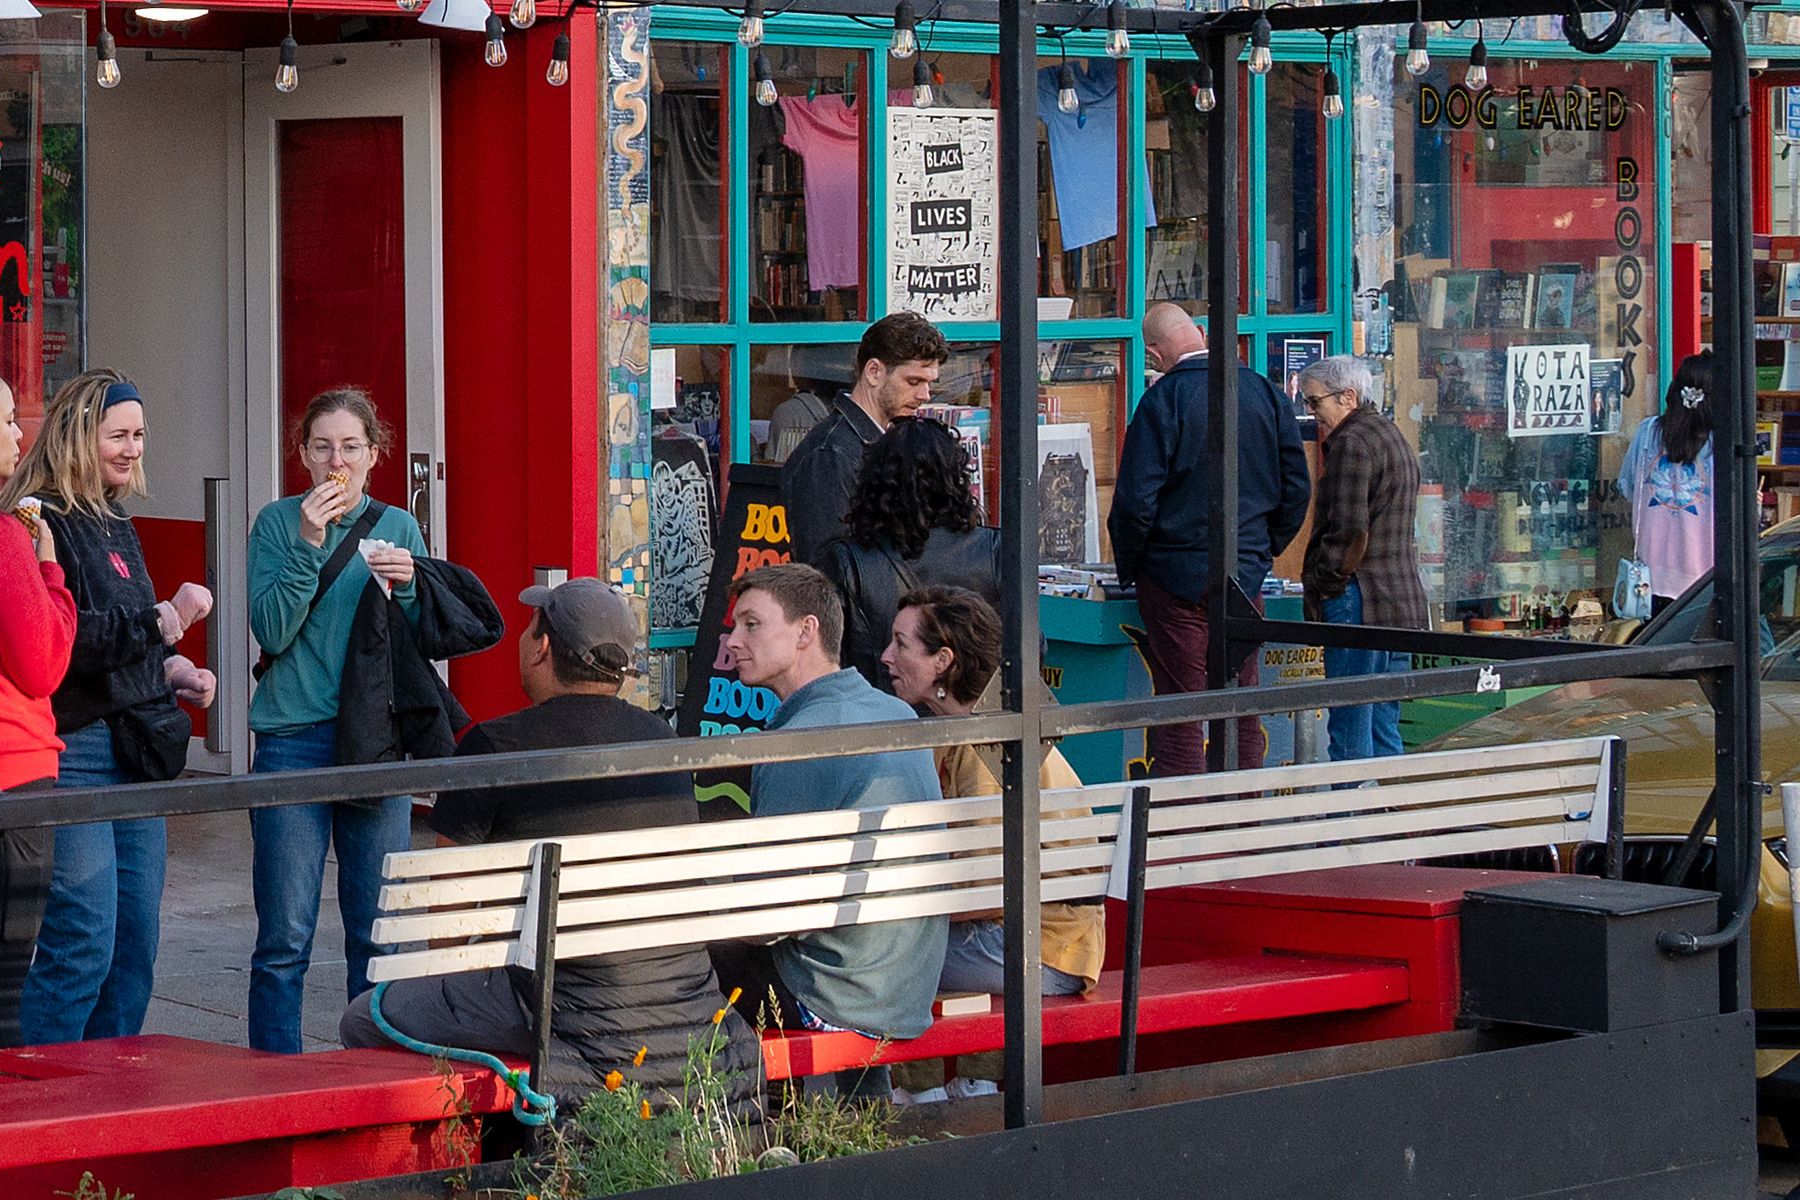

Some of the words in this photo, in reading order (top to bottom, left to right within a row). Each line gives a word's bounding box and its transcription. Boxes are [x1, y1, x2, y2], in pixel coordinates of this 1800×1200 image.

[1417, 82, 1498, 130] DOG
[1517, 84, 1628, 131] EARED
[925, 149, 961, 168] BLACK
[917, 206, 967, 227] LIVES
[910, 266, 978, 290] MATTER
[1615, 156, 1643, 398] BOOKS
[1532, 384, 1585, 412] RAZA
[1264, 649, 1284, 666] DOG
[1286, 646, 1317, 664] EARED
